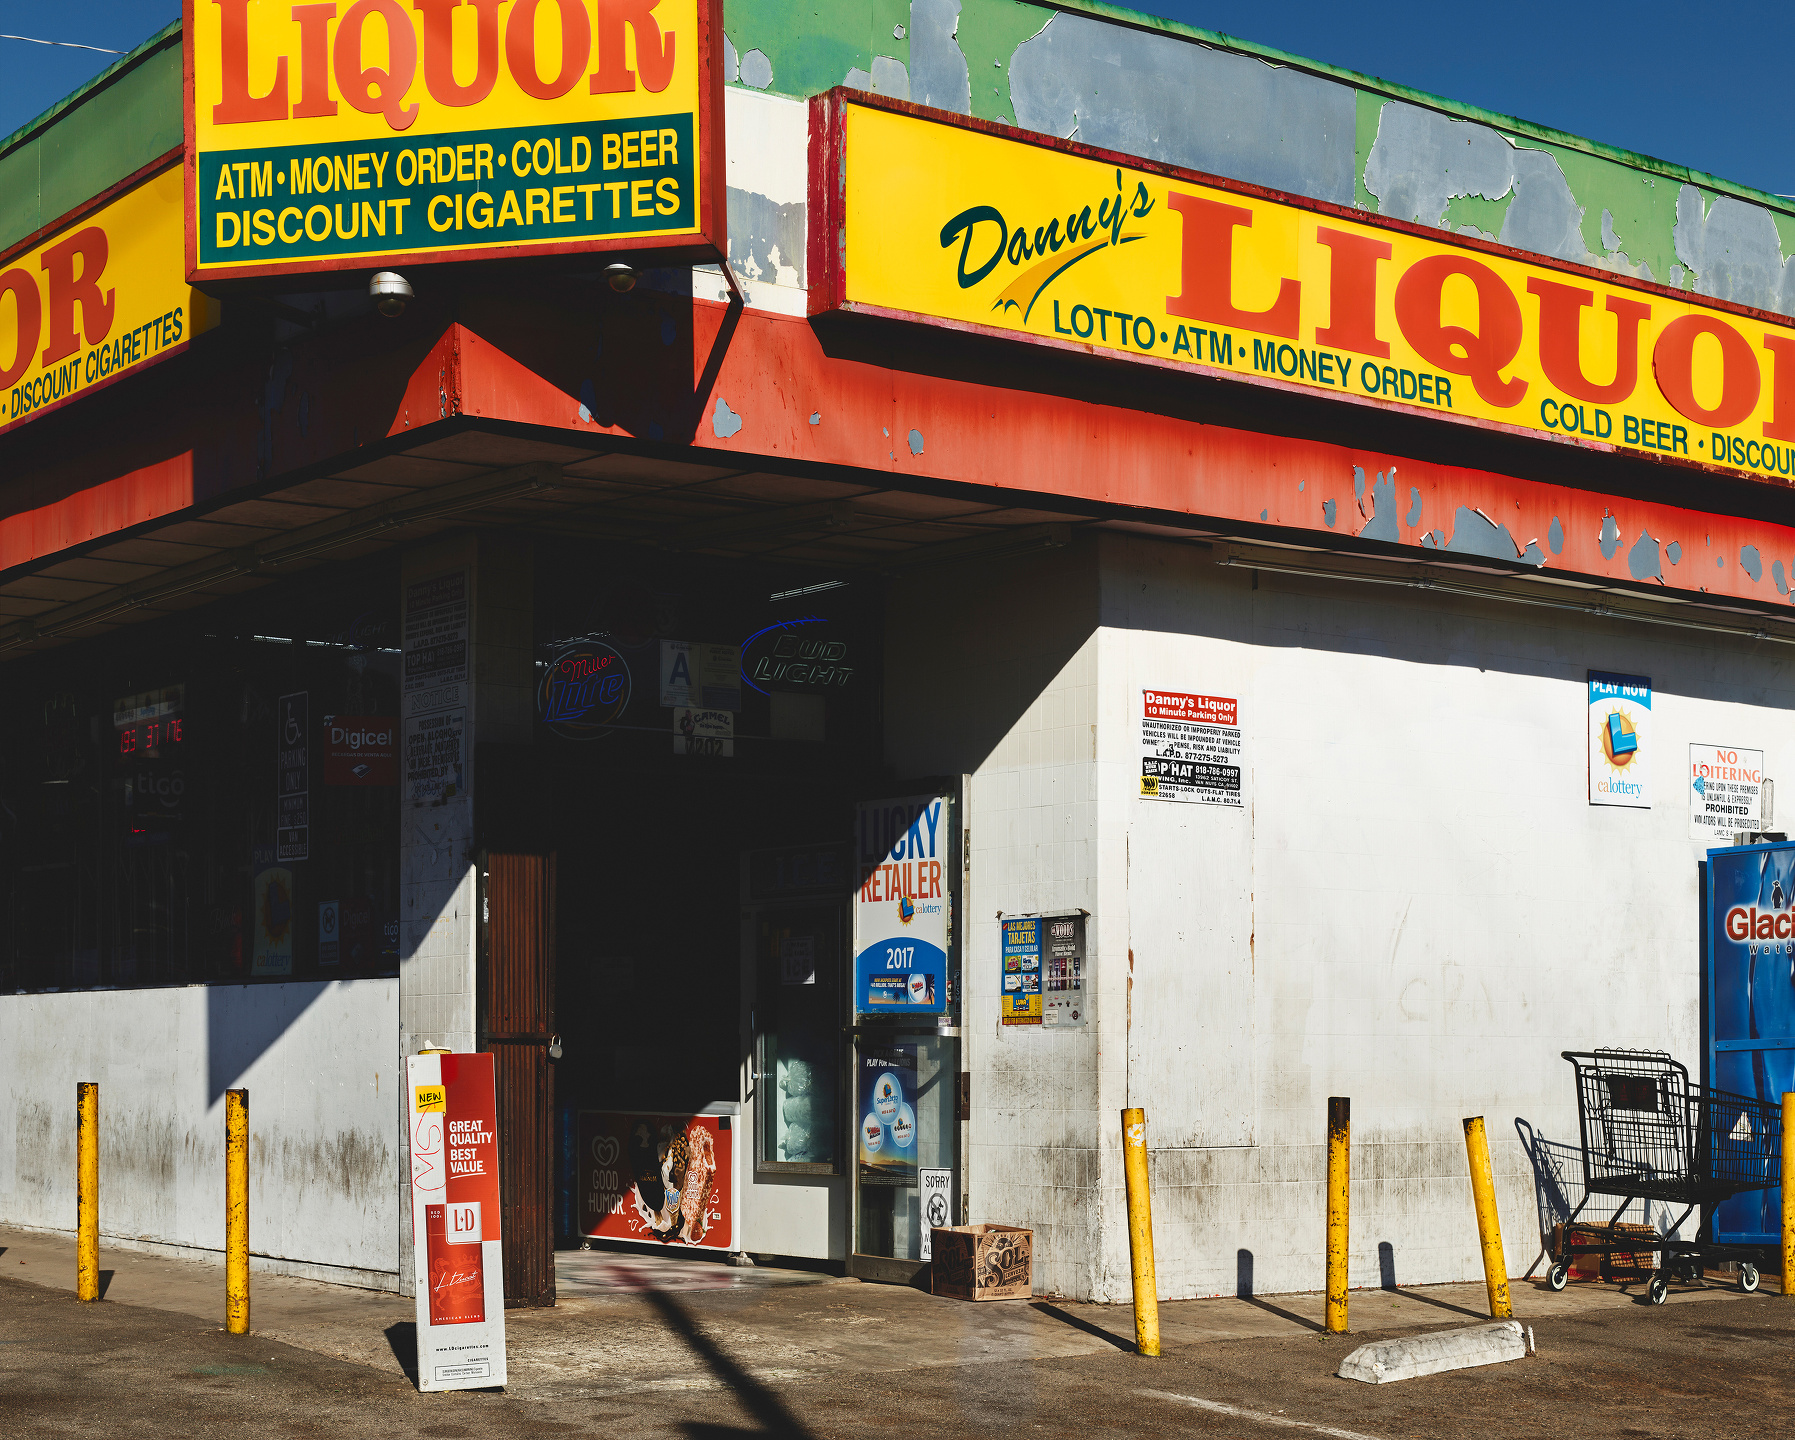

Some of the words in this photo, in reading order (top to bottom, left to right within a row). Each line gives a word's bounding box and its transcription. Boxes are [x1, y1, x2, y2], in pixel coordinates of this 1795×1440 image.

[212, 0, 675, 131] LIQUOR
[216, 160, 272, 200] ATM
[290, 152, 389, 195] MONEY
[396, 143, 494, 186] ORDER
[511, 136, 592, 178] COLD
[602, 128, 678, 170] BEER
[216, 198, 411, 248] DISCOUNT
[427, 177, 680, 233] CIGARETTES
[940, 168, 1156, 289] Danny's
[11, 357, 81, 419] DISCOUNT
[86, 307, 183, 383] CIGARETTES
[1054, 300, 1155, 350] LOTTO
[1172, 324, 1232, 365] ATM
[1253, 338, 1351, 388] MONEY
[1361, 361, 1452, 408] ORDER
[1541, 399, 1612, 439] COLD
[1623, 415, 1688, 455] BEER
[408, 582, 437, 598] Danny's
[439, 575, 464, 591] Liquor
[772, 634, 848, 662] BUD
[406, 654, 421, 667] TOP
[560, 654, 617, 682] Miller
[669, 652, 692, 686] A
[754, 656, 855, 687] LIGHT
[1592, 680, 1619, 694] PLAY
[1622, 682, 1648, 697] NOW
[411, 686, 459, 710] NOTICE
[542, 674, 624, 722] Lite
[1146, 692, 1194, 709] Danny's
[1198, 698, 1236, 713] Liquor
[445, 715, 452, 725] OF
[693, 711, 731, 726] CAMEL
[1148, 706, 1157, 714] 10
[1159, 707, 1186, 717] Minute
[1188, 710, 1217, 721] Parking
[1218, 713, 1234, 723] Only
[1142, 721, 1182, 731] UNAUTHORIZED
[1191, 726, 1221, 737] IMPROPERLY
[1222, 730, 1241, 738] PARKED
[331, 727, 393, 750] Digicel
[408, 733, 426, 746] OPEN
[1143, 730, 1166, 739] VEHICLES
[1167, 732, 1179, 740] WILL
[1188, 735, 1215, 744] IMPOUNDED
[1222, 738, 1241, 747] VEHICLE
[1193, 743, 1205, 751] RISK
[1218, 746, 1241, 755] LIABILITY
[1717, 750, 1738, 765] NO
[281, 747, 306, 769] PARKING
[1185, 752, 1229, 764] 877-275-5273
[1172, 763, 1194, 778] HAT
[1195, 765, 1239, 777] 818-786-0997
[1693, 763, 1760, 783] LOITERING
[285, 770, 301, 791] ONLY
[1597, 777, 1643, 799] calottery
[1716, 783, 1726, 791] UPON
[1727, 784, 1739, 793] THESE
[1740, 785, 1758, 795] PREMISES
[1159, 784, 1195, 793] STARTS-LOCK
[1197, 787, 1224, 796] OUTS-FLAT
[1226, 789, 1241, 797] TIRES
[1707, 793, 1725, 803] UNLAWFUL
[1732, 795, 1752, 805] EXPRESSLY
[1705, 803, 1749, 815] PROHIBITED
[1694, 814, 1716, 826] VIOLATORS
[1717, 816, 1727, 827] WILL
[1728, 818, 1734, 827] BE
[1734, 818, 1760, 829] PROSECUTED
[288, 830, 299, 842] VAN
[861, 801, 942, 862] LUCKY
[279, 843, 307, 856] ACCESSIBLE
[776, 852, 838, 889] ICE
[861, 861, 942, 903] RETAILER
[915, 903, 942, 916] calottery
[1008, 922, 1016, 931] LAS
[1016, 921, 1036, 931] MEJORES
[1008, 931, 1036, 945] TARJETAS
[886, 946, 914, 970] 2017
[866, 1058, 878, 1067] PLAY
[419, 1092, 442, 1104] NEW
[449, 1120, 483, 1133] GREAT
[449, 1131, 493, 1147] QUALITY
[450, 1148, 477, 1161] BEST
[450, 1160, 484, 1173] VALUE
[592, 1169, 619, 1190] GOOD
[925, 1175, 950, 1188] SORRY
[588, 1193, 624, 1215] HUMOR
[985, 1245, 1025, 1287] SOL
